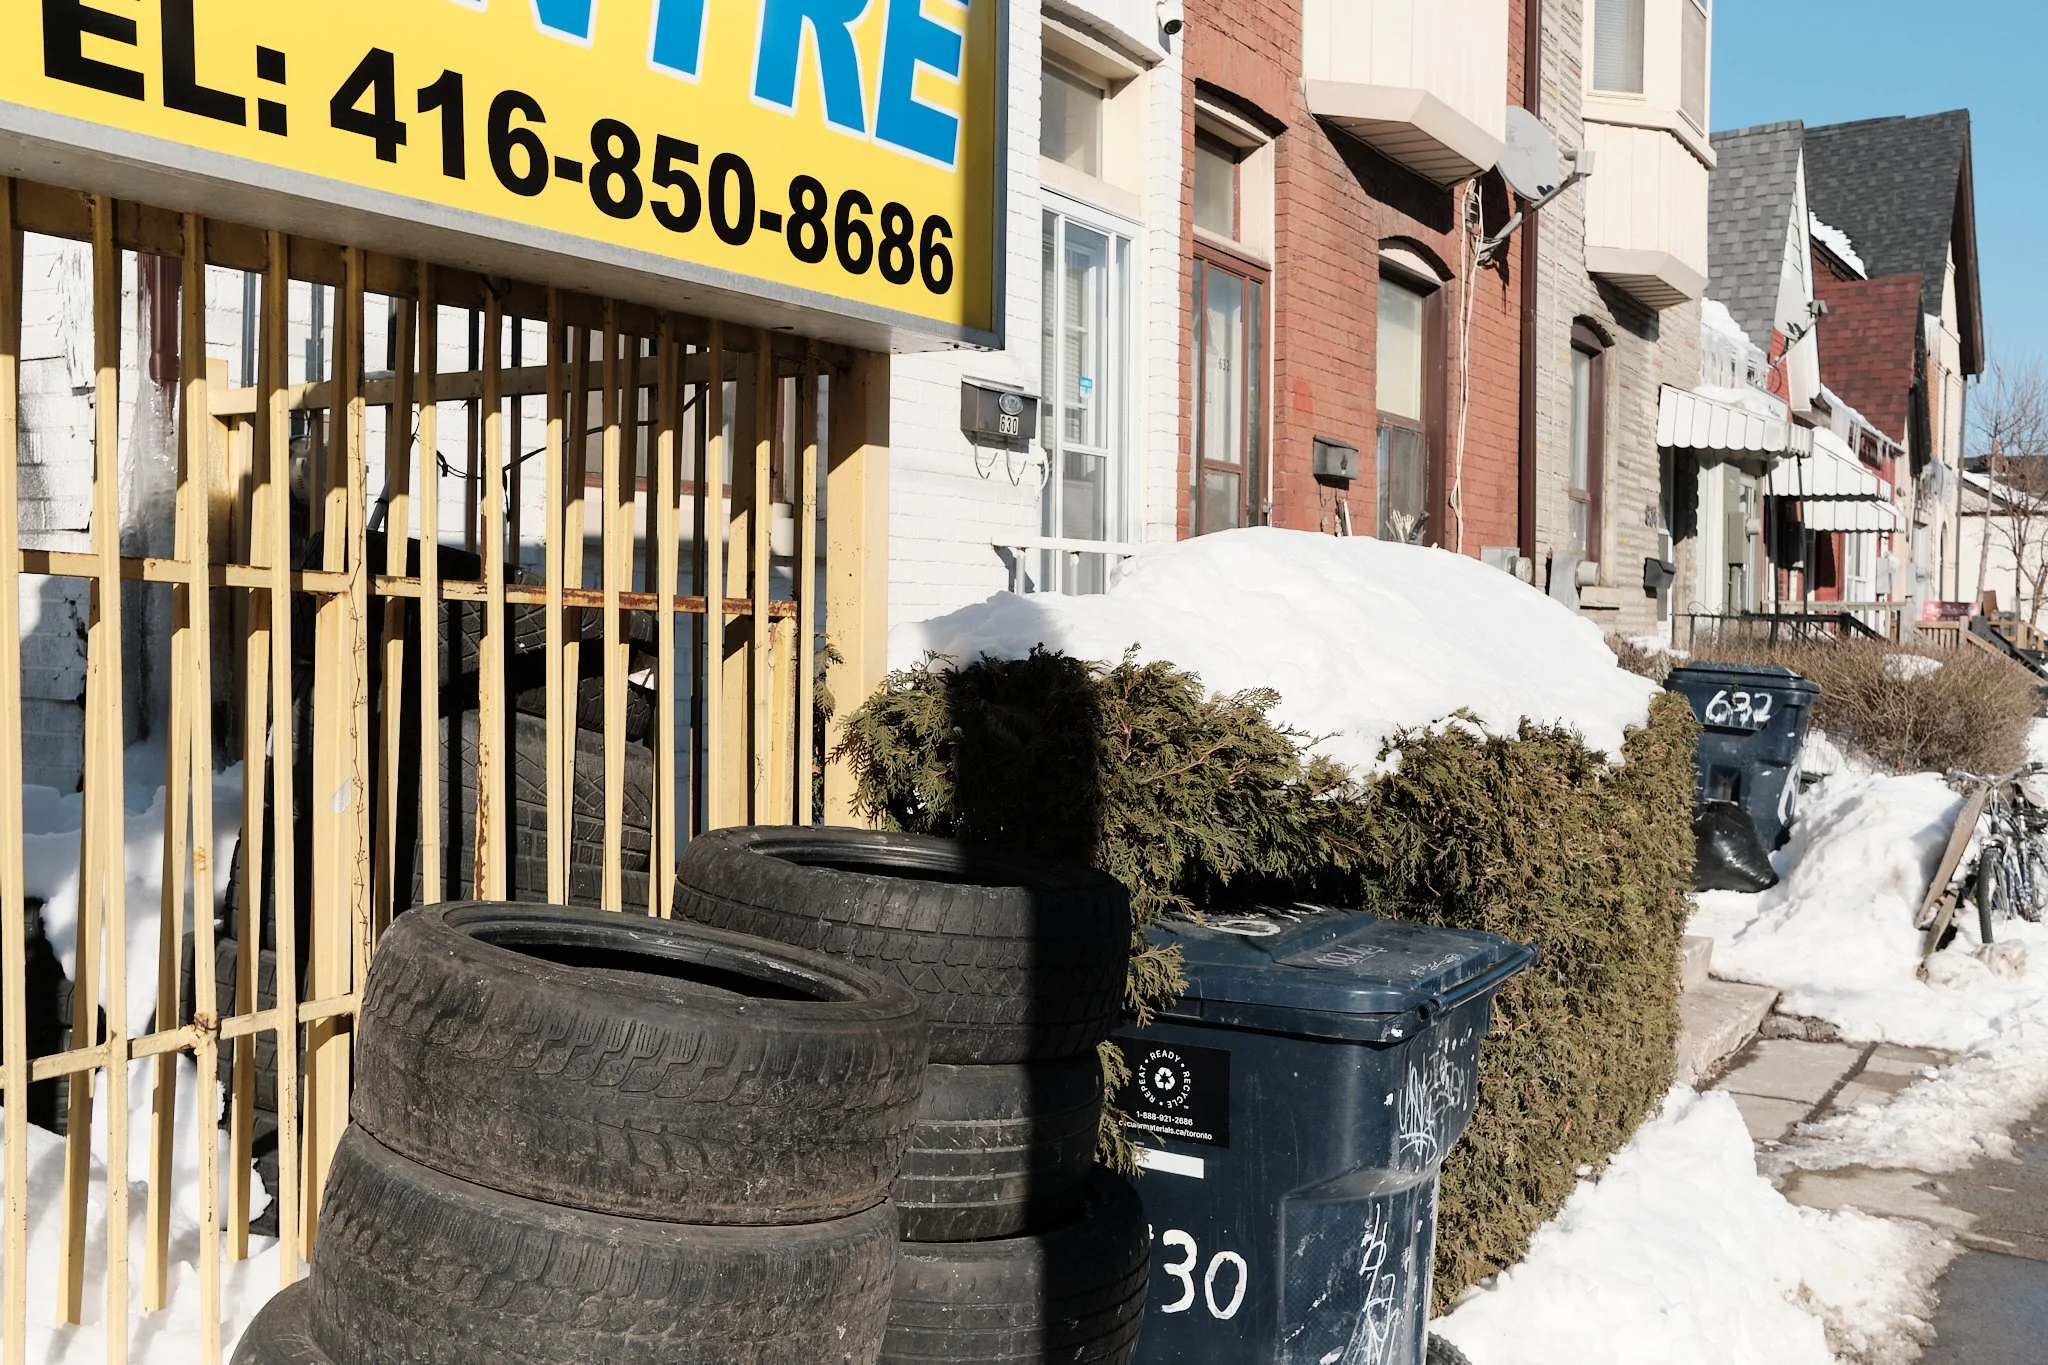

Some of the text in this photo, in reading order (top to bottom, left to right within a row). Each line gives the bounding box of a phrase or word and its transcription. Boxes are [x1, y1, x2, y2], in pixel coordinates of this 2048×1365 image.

[330, 47, 954, 295] 416-850-8686
[1001, 416, 1018, 434] 630
[1705, 689, 1773, 725] 632
[1138, 1050, 1191, 1109] READY RECYCLE REPEAT
[1147, 1223, 1248, 1320] 30
